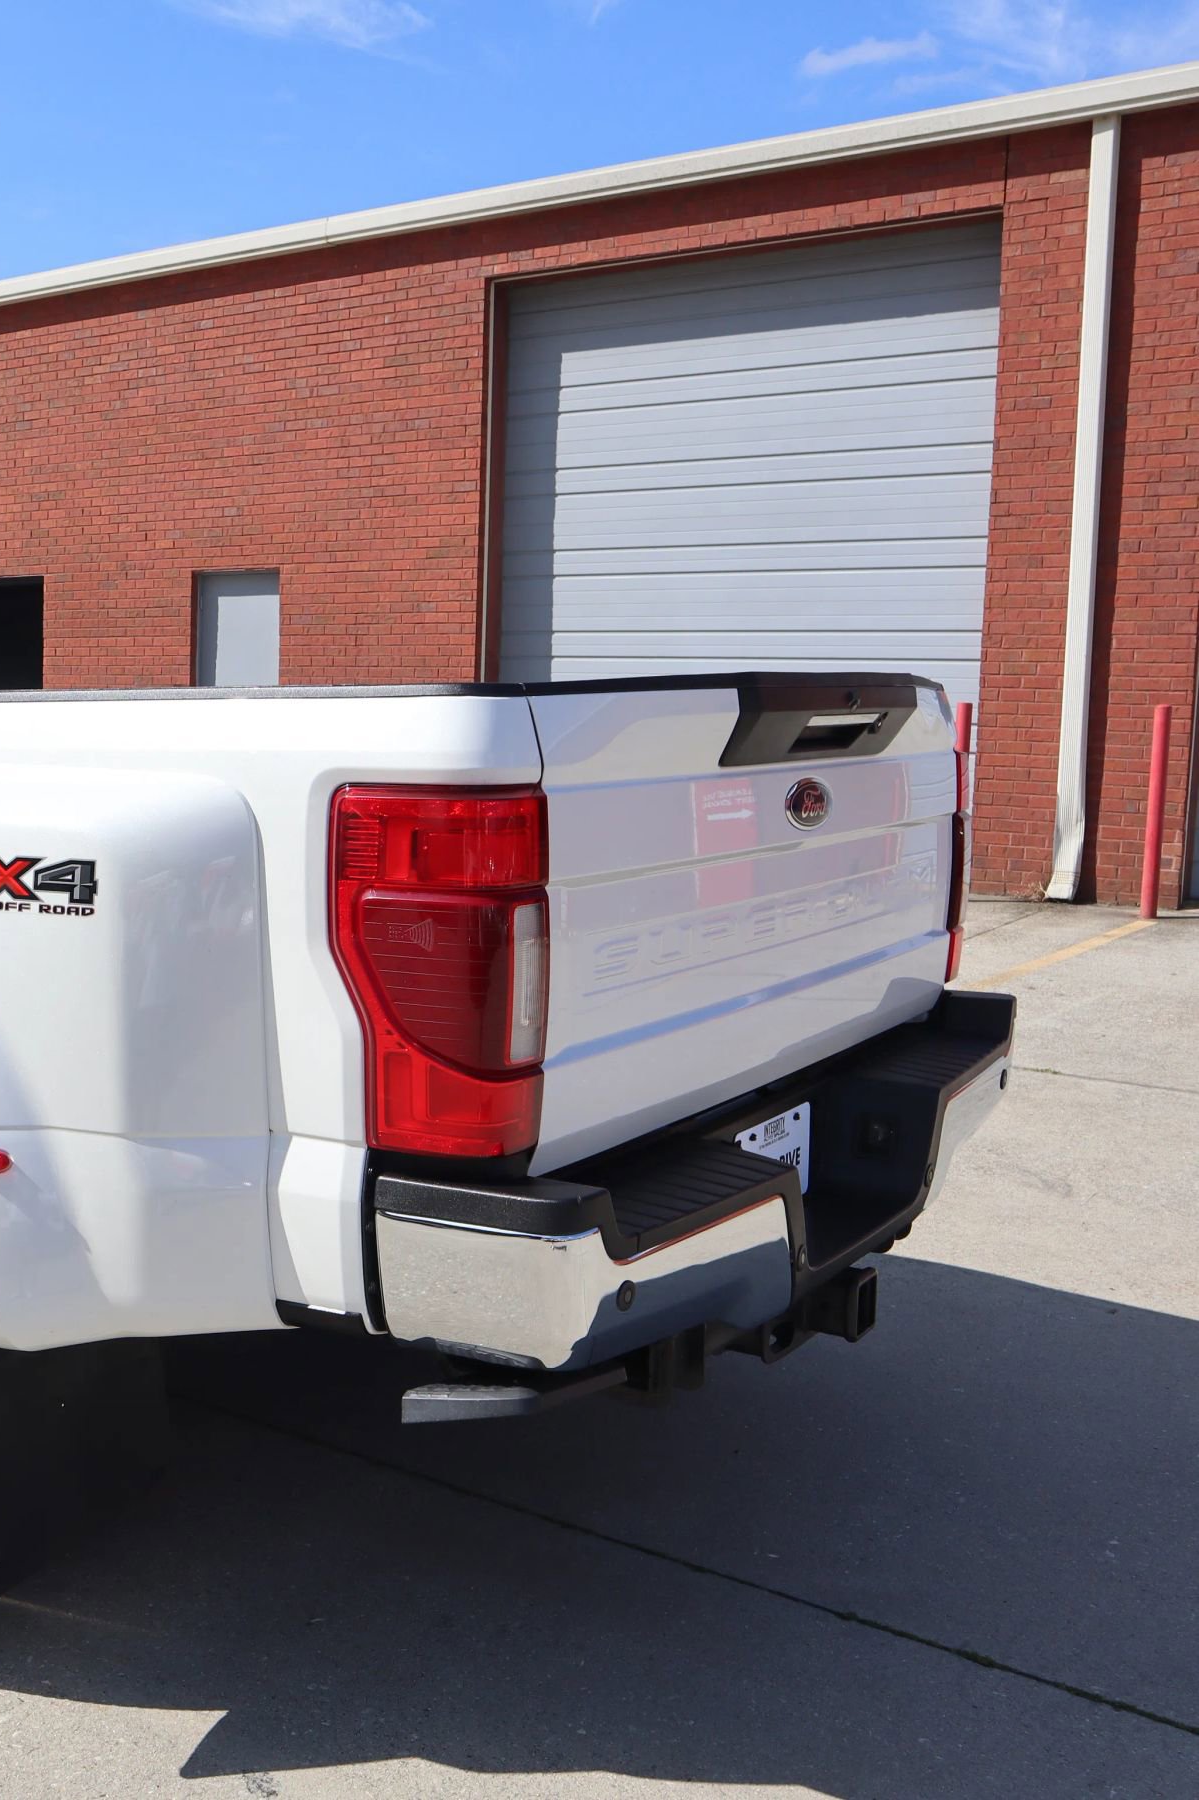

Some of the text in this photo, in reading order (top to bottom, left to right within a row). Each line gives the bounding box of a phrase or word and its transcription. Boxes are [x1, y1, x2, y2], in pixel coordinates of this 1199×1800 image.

[800, 786, 827, 819] Ford
[38, 903, 95, 917] ROAD
[763, 1115, 786, 1139] INTEGRITY
